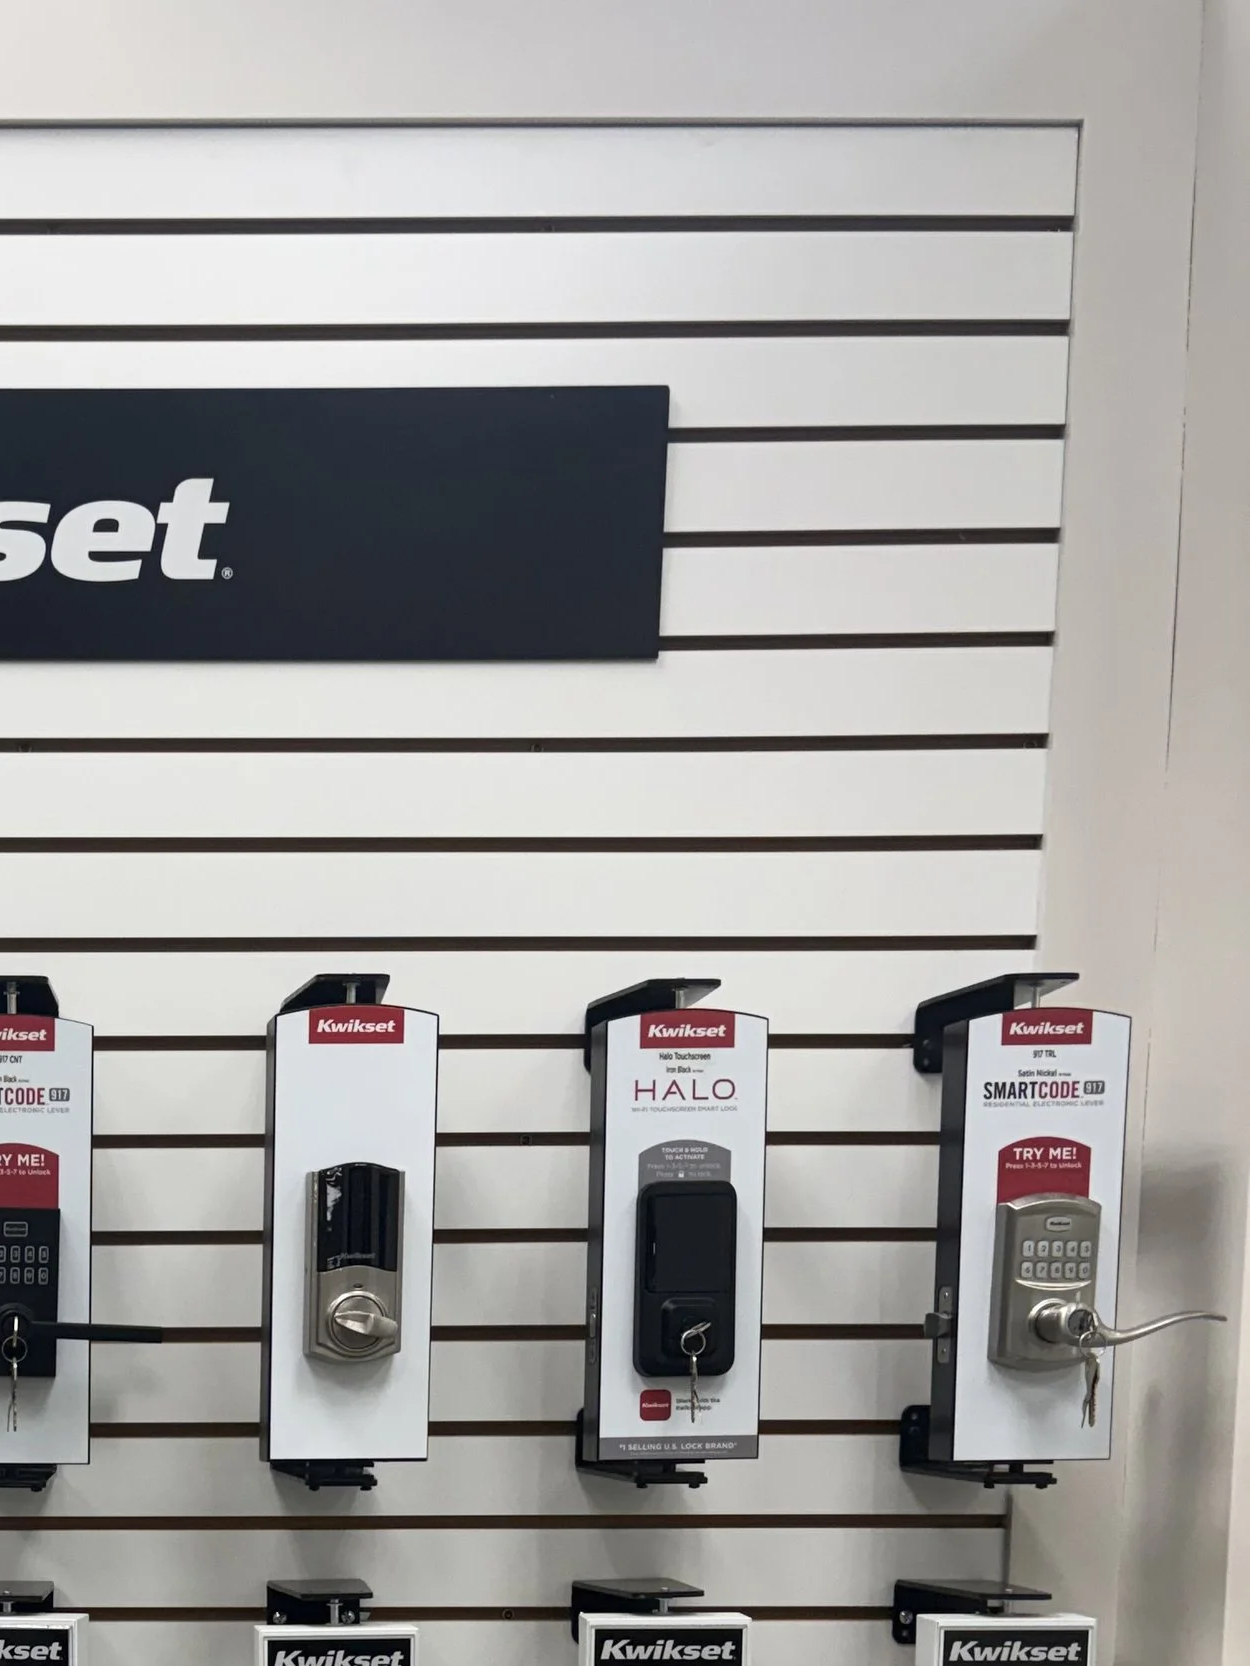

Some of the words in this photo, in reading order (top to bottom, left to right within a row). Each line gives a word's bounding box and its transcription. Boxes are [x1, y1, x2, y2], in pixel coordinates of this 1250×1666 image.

[316, 1019, 396, 1033] Kwikset
[647, 1023, 727, 1038] Kwikset
[1009, 1021, 1085, 1036] Kwikset
[659, 1052, 673, 1060] Halo
[674, 1052, 711, 1060] Touchscreen
[1033, 1050, 1044, 1058] 917
[1044, 1050, 1057, 1058] TRL
[666, 1066, 676, 1074] Iron
[677, 1066, 691, 1074] Black
[3, 1075, 17, 1083] Black
[50, 1089, 68, 1100] 917
[634, 1078, 736, 1101] HALO
[983, 1081, 1080, 1100] SMARTCODE
[1085, 1082, 1104, 1093] 917
[17, 1154, 45, 1166] ME!
[1013, 1148, 1044, 1160] TRY
[1049, 1148, 1077, 1160] ME!
[705, 1442, 734, 1450] BRAND
[600, 1639, 736, 1661] Kwikset
[948, 1640, 1082, 1662] Kwikset
